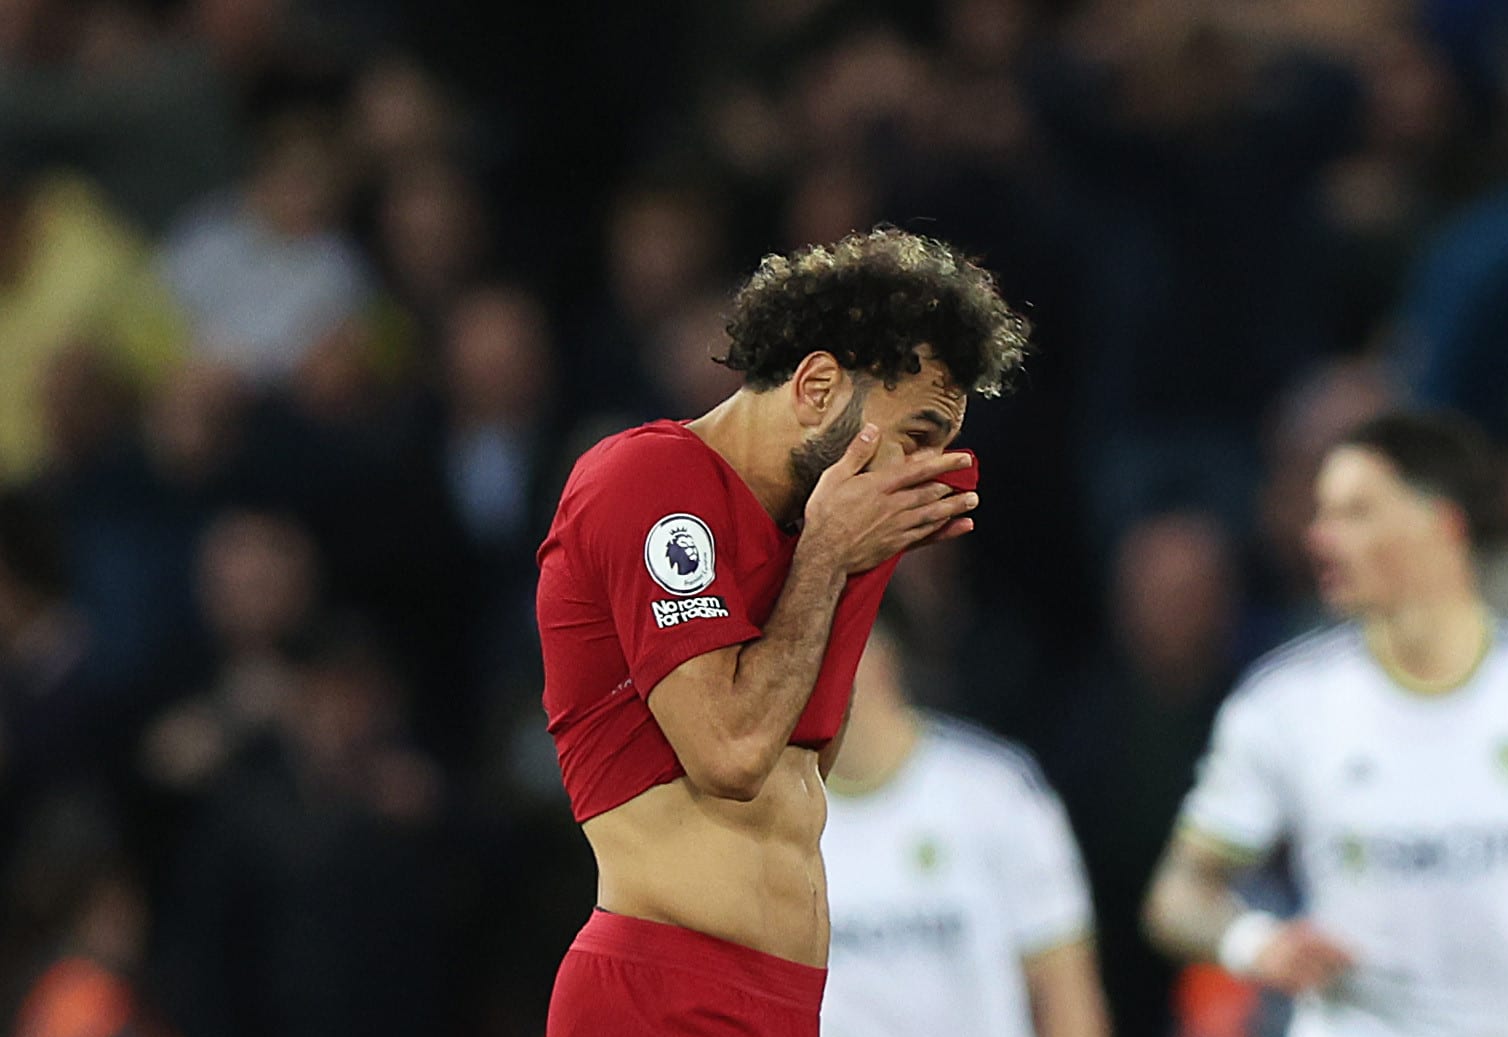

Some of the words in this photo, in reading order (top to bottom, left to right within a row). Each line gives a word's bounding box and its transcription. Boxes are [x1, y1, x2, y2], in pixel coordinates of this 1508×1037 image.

[652, 600, 678, 616] No
[678, 597, 720, 612] room
[655, 612, 680, 628] for
